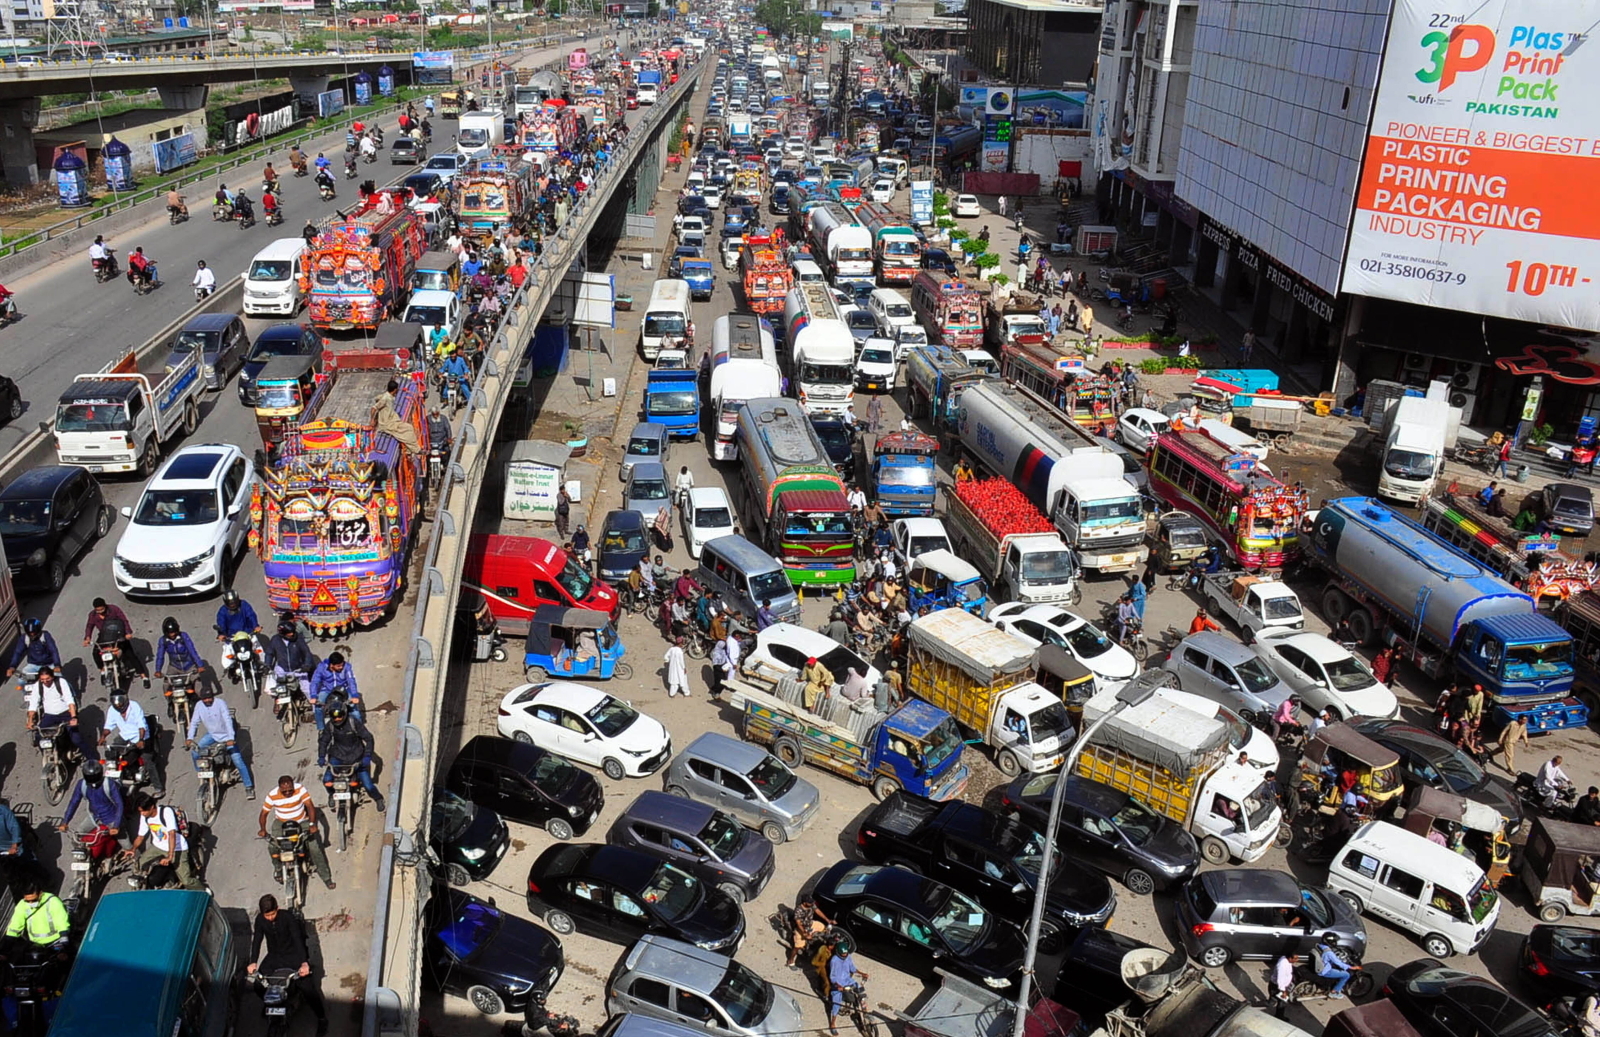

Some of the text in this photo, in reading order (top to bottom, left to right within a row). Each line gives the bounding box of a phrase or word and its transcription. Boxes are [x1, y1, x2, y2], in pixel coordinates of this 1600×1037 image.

[1429, 13, 1465, 28] 22nd
[1509, 26, 1564, 50] Plas
[1415, 24, 1495, 93] 3P
[1503, 51, 1564, 76] Print
[1497, 76, 1559, 101] Pack
[1465, 101, 1559, 119] PAKISTAN
[1387, 121, 1470, 144] PIONEER
[1474, 131, 1487, 146] &
[1493, 132, 1587, 154] BIGGEST
[1383, 140, 1471, 166] PLASTIC
[1378, 163, 1507, 198] PRINTING
[1373, 189, 1541, 230] PACKAGING
[1369, 214, 1485, 246] INDUSTRY
[1202, 223, 1231, 251] EXPRESS
[1238, 246, 1259, 271] PIZZA
[1266, 265, 1292, 292] FRIED
[1292, 284, 1335, 322] CHICKEN
[1360, 258, 1467, 286] 021-35810637-9
[1410, 256, 1449, 267] INFORMATION
[1505, 259, 1578, 296] 10TH
